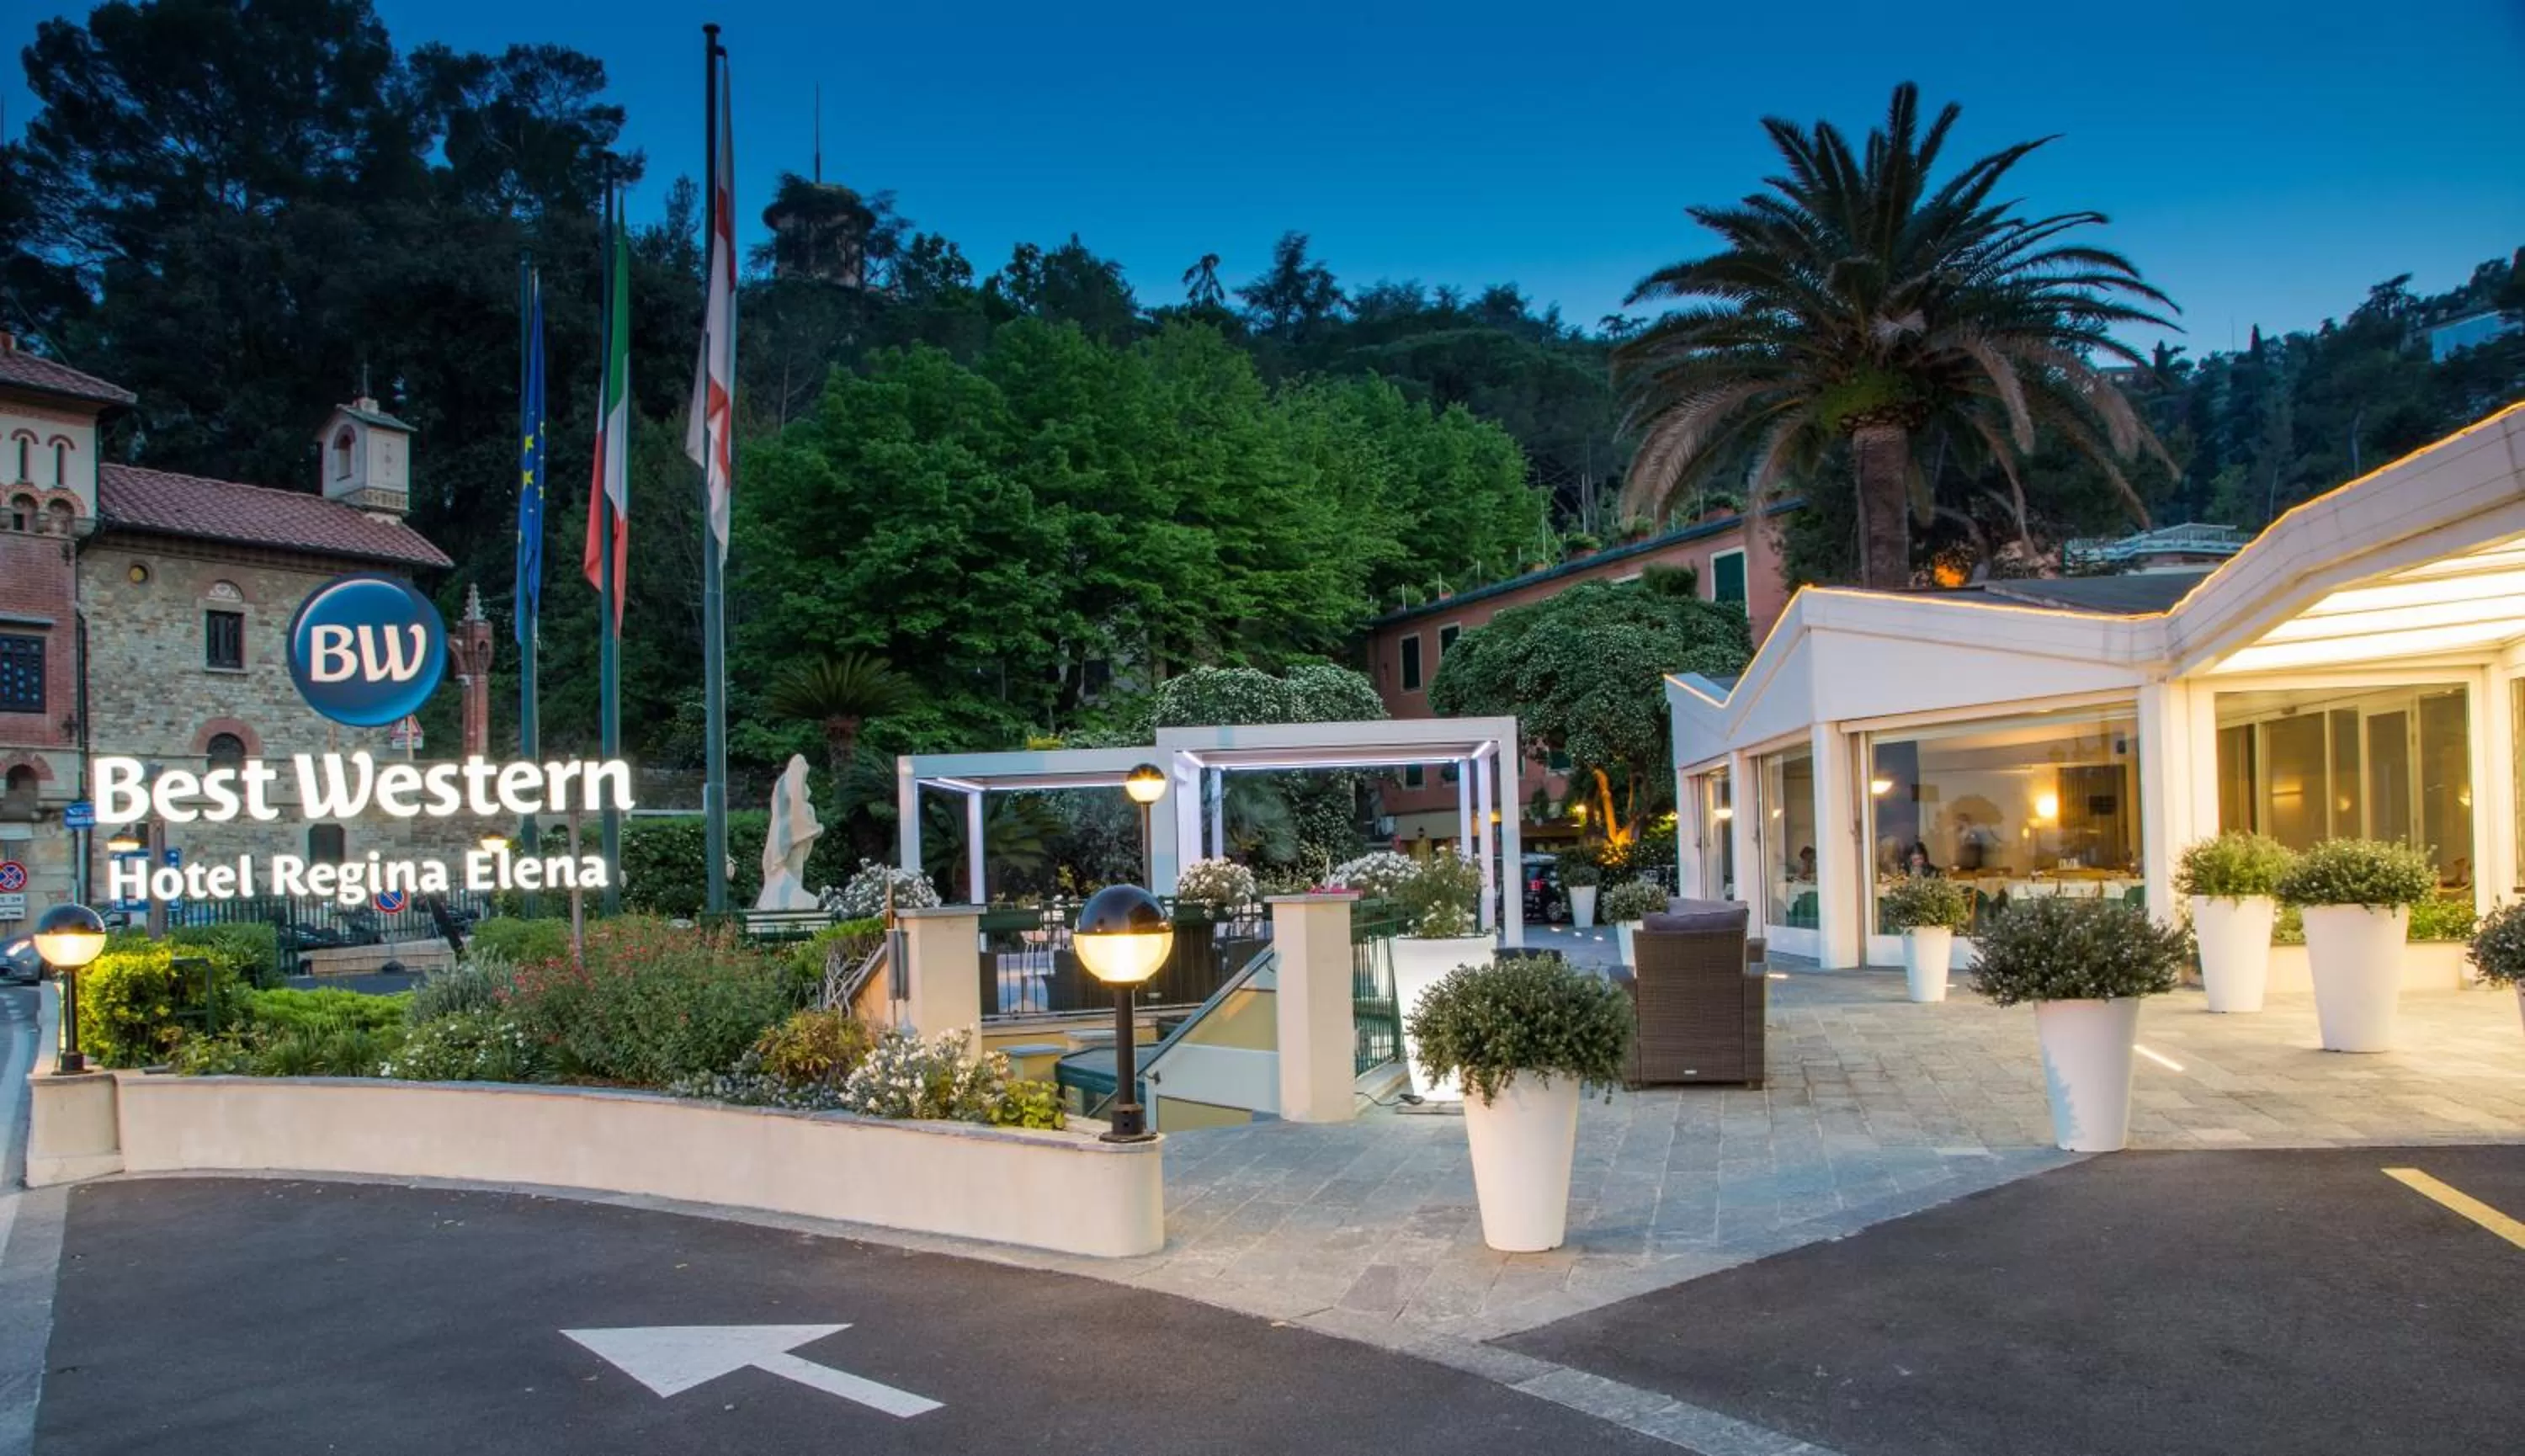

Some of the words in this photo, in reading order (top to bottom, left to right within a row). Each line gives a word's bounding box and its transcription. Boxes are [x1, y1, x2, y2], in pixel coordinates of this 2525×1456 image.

[311, 623, 427, 683] BW
[93, 756, 279, 824] Best
[294, 751, 635, 820] Western
[109, 855, 254, 901] Hotel
[273, 851, 449, 906] Regina
[466, 841, 609, 890] Elena
